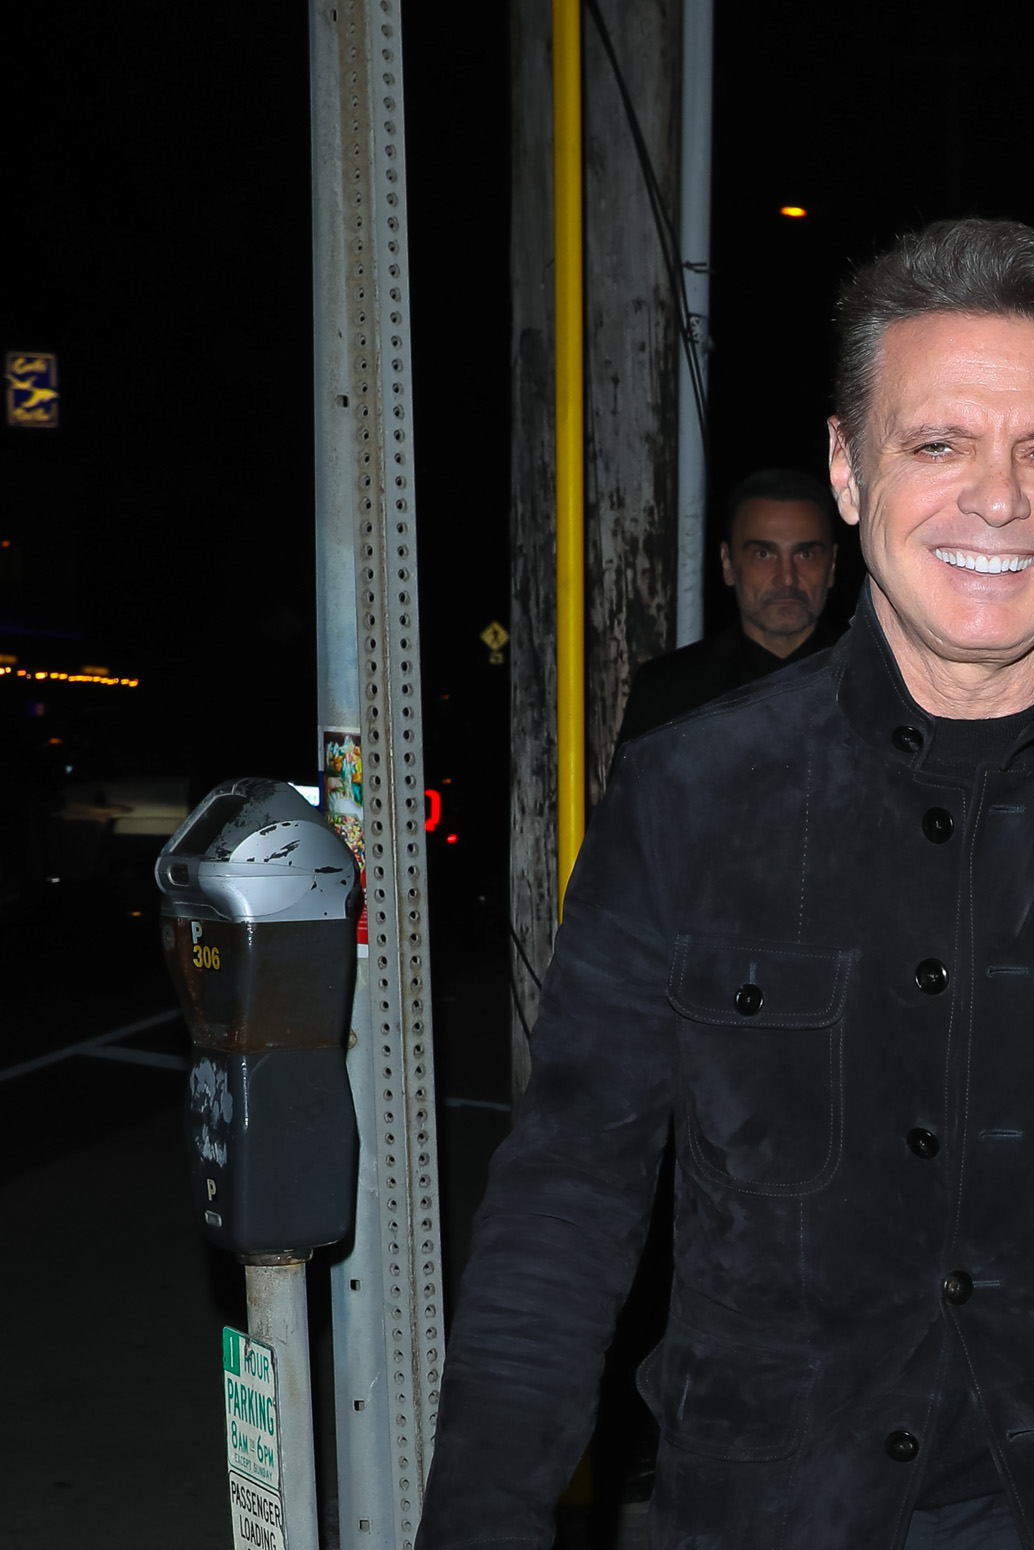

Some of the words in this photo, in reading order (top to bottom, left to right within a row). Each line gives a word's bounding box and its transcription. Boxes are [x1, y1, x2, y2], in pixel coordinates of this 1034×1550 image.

[191, 920, 203, 944] P
[192, 944, 221, 970] 306
[206, 1179, 217, 1202] P
[244, 1345, 270, 1384] HOUR
[227, 1377, 275, 1437] PARKING
[234, 1452, 252, 1473] EXCEPT
[253, 1462, 273, 1482] SUNDAY
[231, 1480, 283, 1529] PASSENGER
